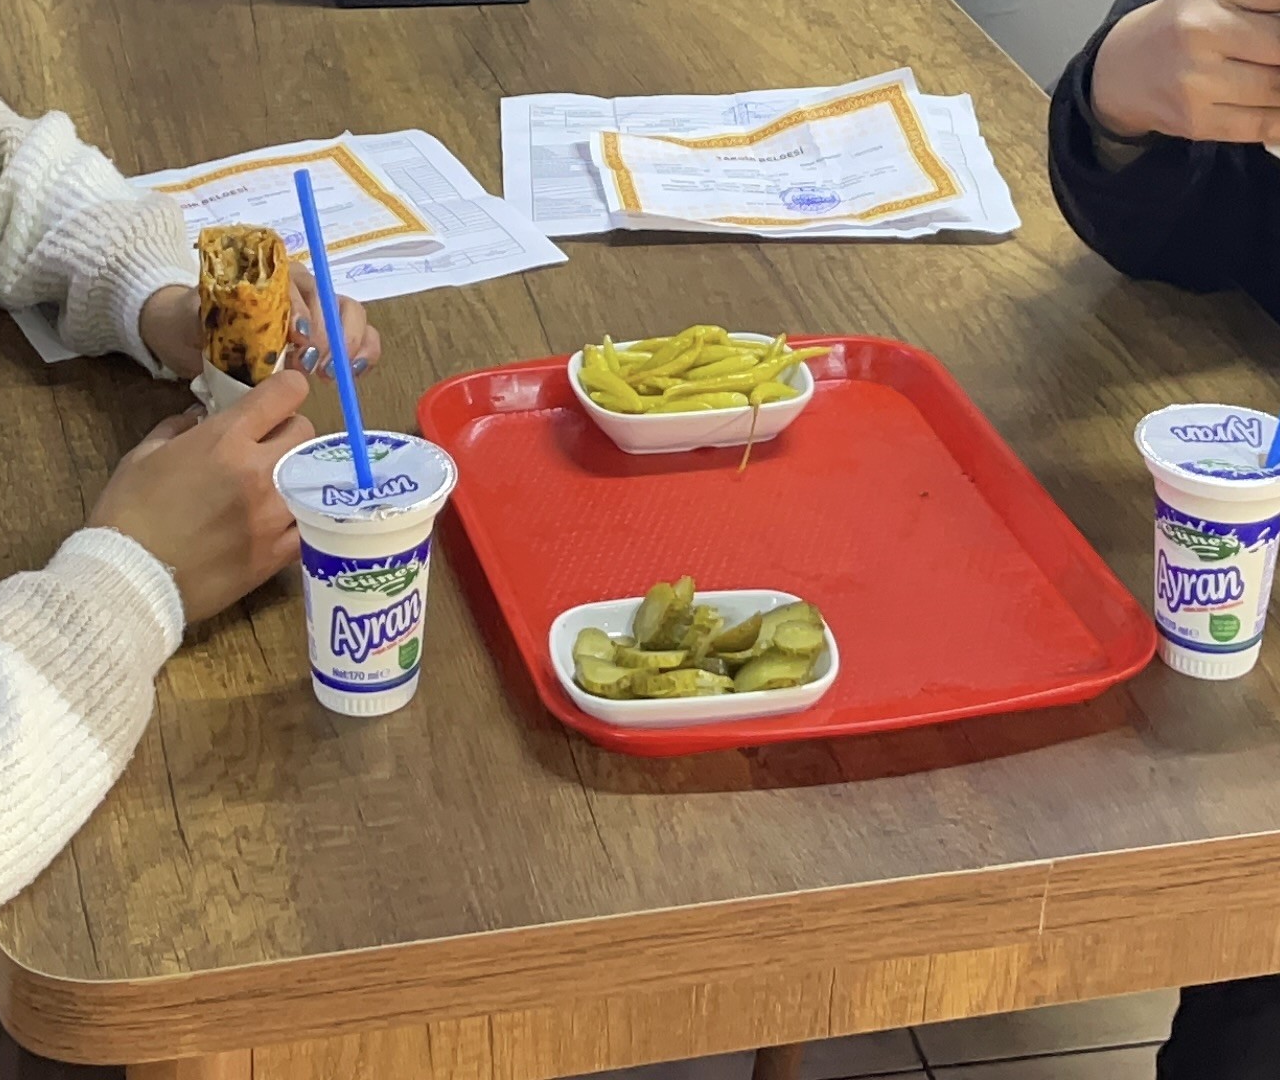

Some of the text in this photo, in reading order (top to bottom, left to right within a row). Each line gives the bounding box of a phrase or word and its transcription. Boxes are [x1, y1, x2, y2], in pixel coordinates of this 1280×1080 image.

[1171, 415, 1263, 448] Ayran
[322, 474, 419, 507] Ayran
[1158, 549, 1245, 613] Ayran
[331, 588, 422, 663] Ayran
